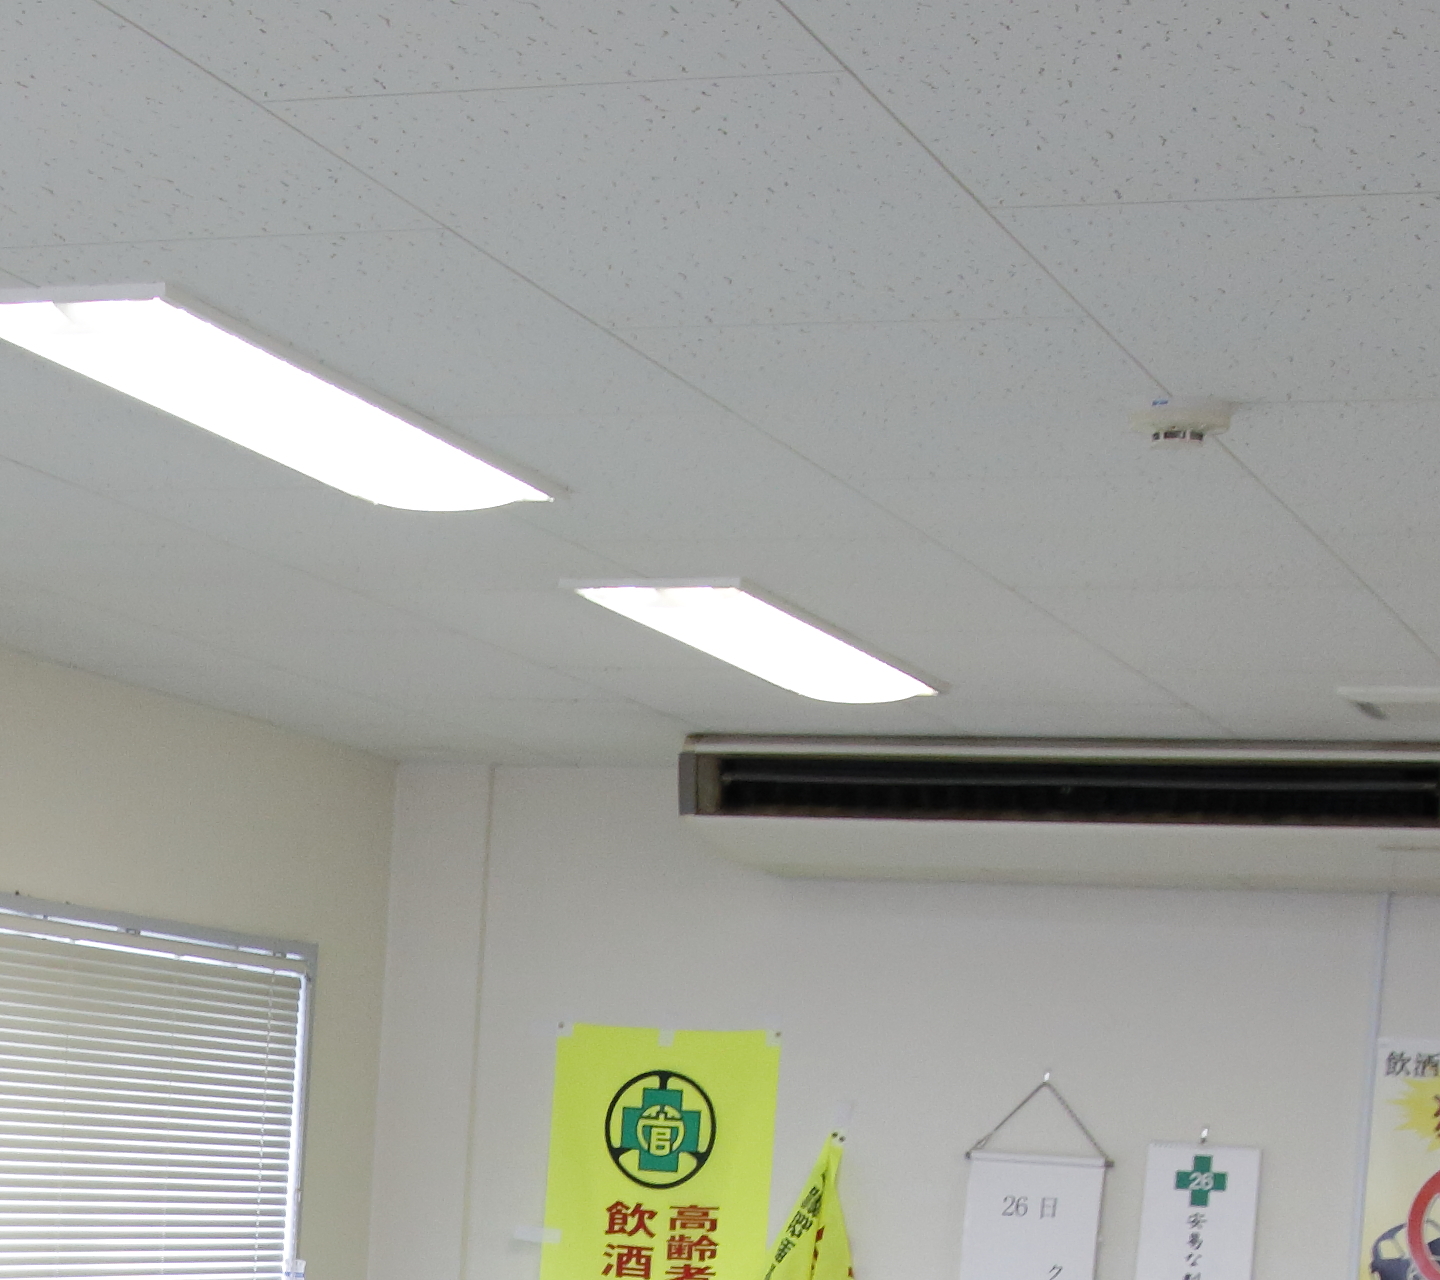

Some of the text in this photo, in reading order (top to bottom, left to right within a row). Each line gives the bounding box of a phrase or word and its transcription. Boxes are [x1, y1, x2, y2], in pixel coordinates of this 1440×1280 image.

[1188, 1171, 1215, 1191] 26
[1002, 1195, 1058, 1219] 26 日
